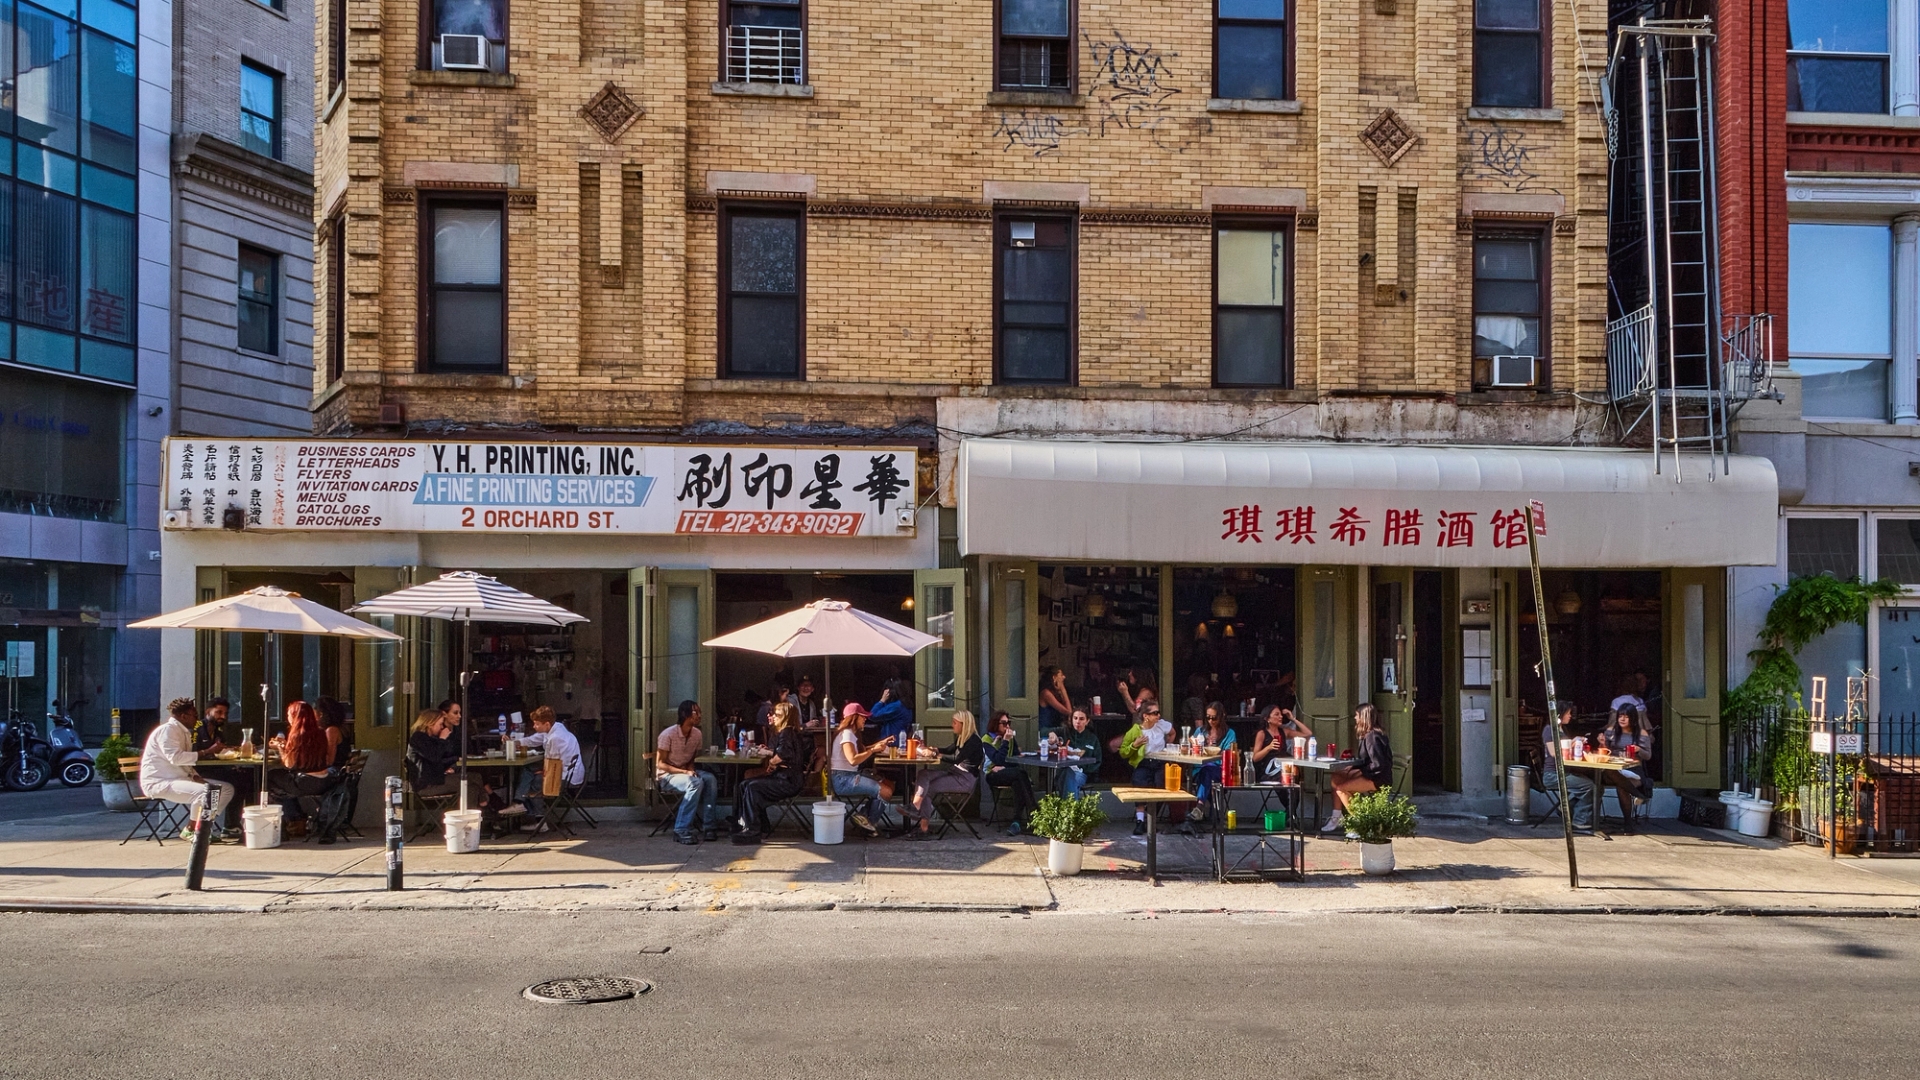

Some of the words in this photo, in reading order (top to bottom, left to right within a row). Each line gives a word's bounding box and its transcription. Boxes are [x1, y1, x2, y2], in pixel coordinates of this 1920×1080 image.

[297, 446, 368, 457] BUSINESS
[370, 447, 417, 458] CARDS
[297, 458, 400, 469] LETTERHEADS
[432, 445, 449, 473] Y.
[456, 445, 476, 473] H.
[486, 445, 591, 475] PRINTING,
[600, 447, 641, 476] INC.
[297, 469, 351, 480] FLYERS
[296, 481, 372, 492] INVITATION
[372, 481, 419, 493] CARDS
[423, 477, 435, 502] A
[437, 478, 473, 503] FINE
[479, 478, 552, 504] PRINTING
[557, 479, 635, 504] SERVICES
[296, 492, 347, 503] MENUS
[297, 504, 371, 515] CATOLOGS
[296, 515, 382, 527] BROCHURES
[461, 507, 475, 527] 2
[484, 510, 579, 528] ORCHARD
[588, 511, 619, 529] ST.
[680, 512, 854, 534] TEL.212-343-9092
[1385, 667, 1393, 682] A
